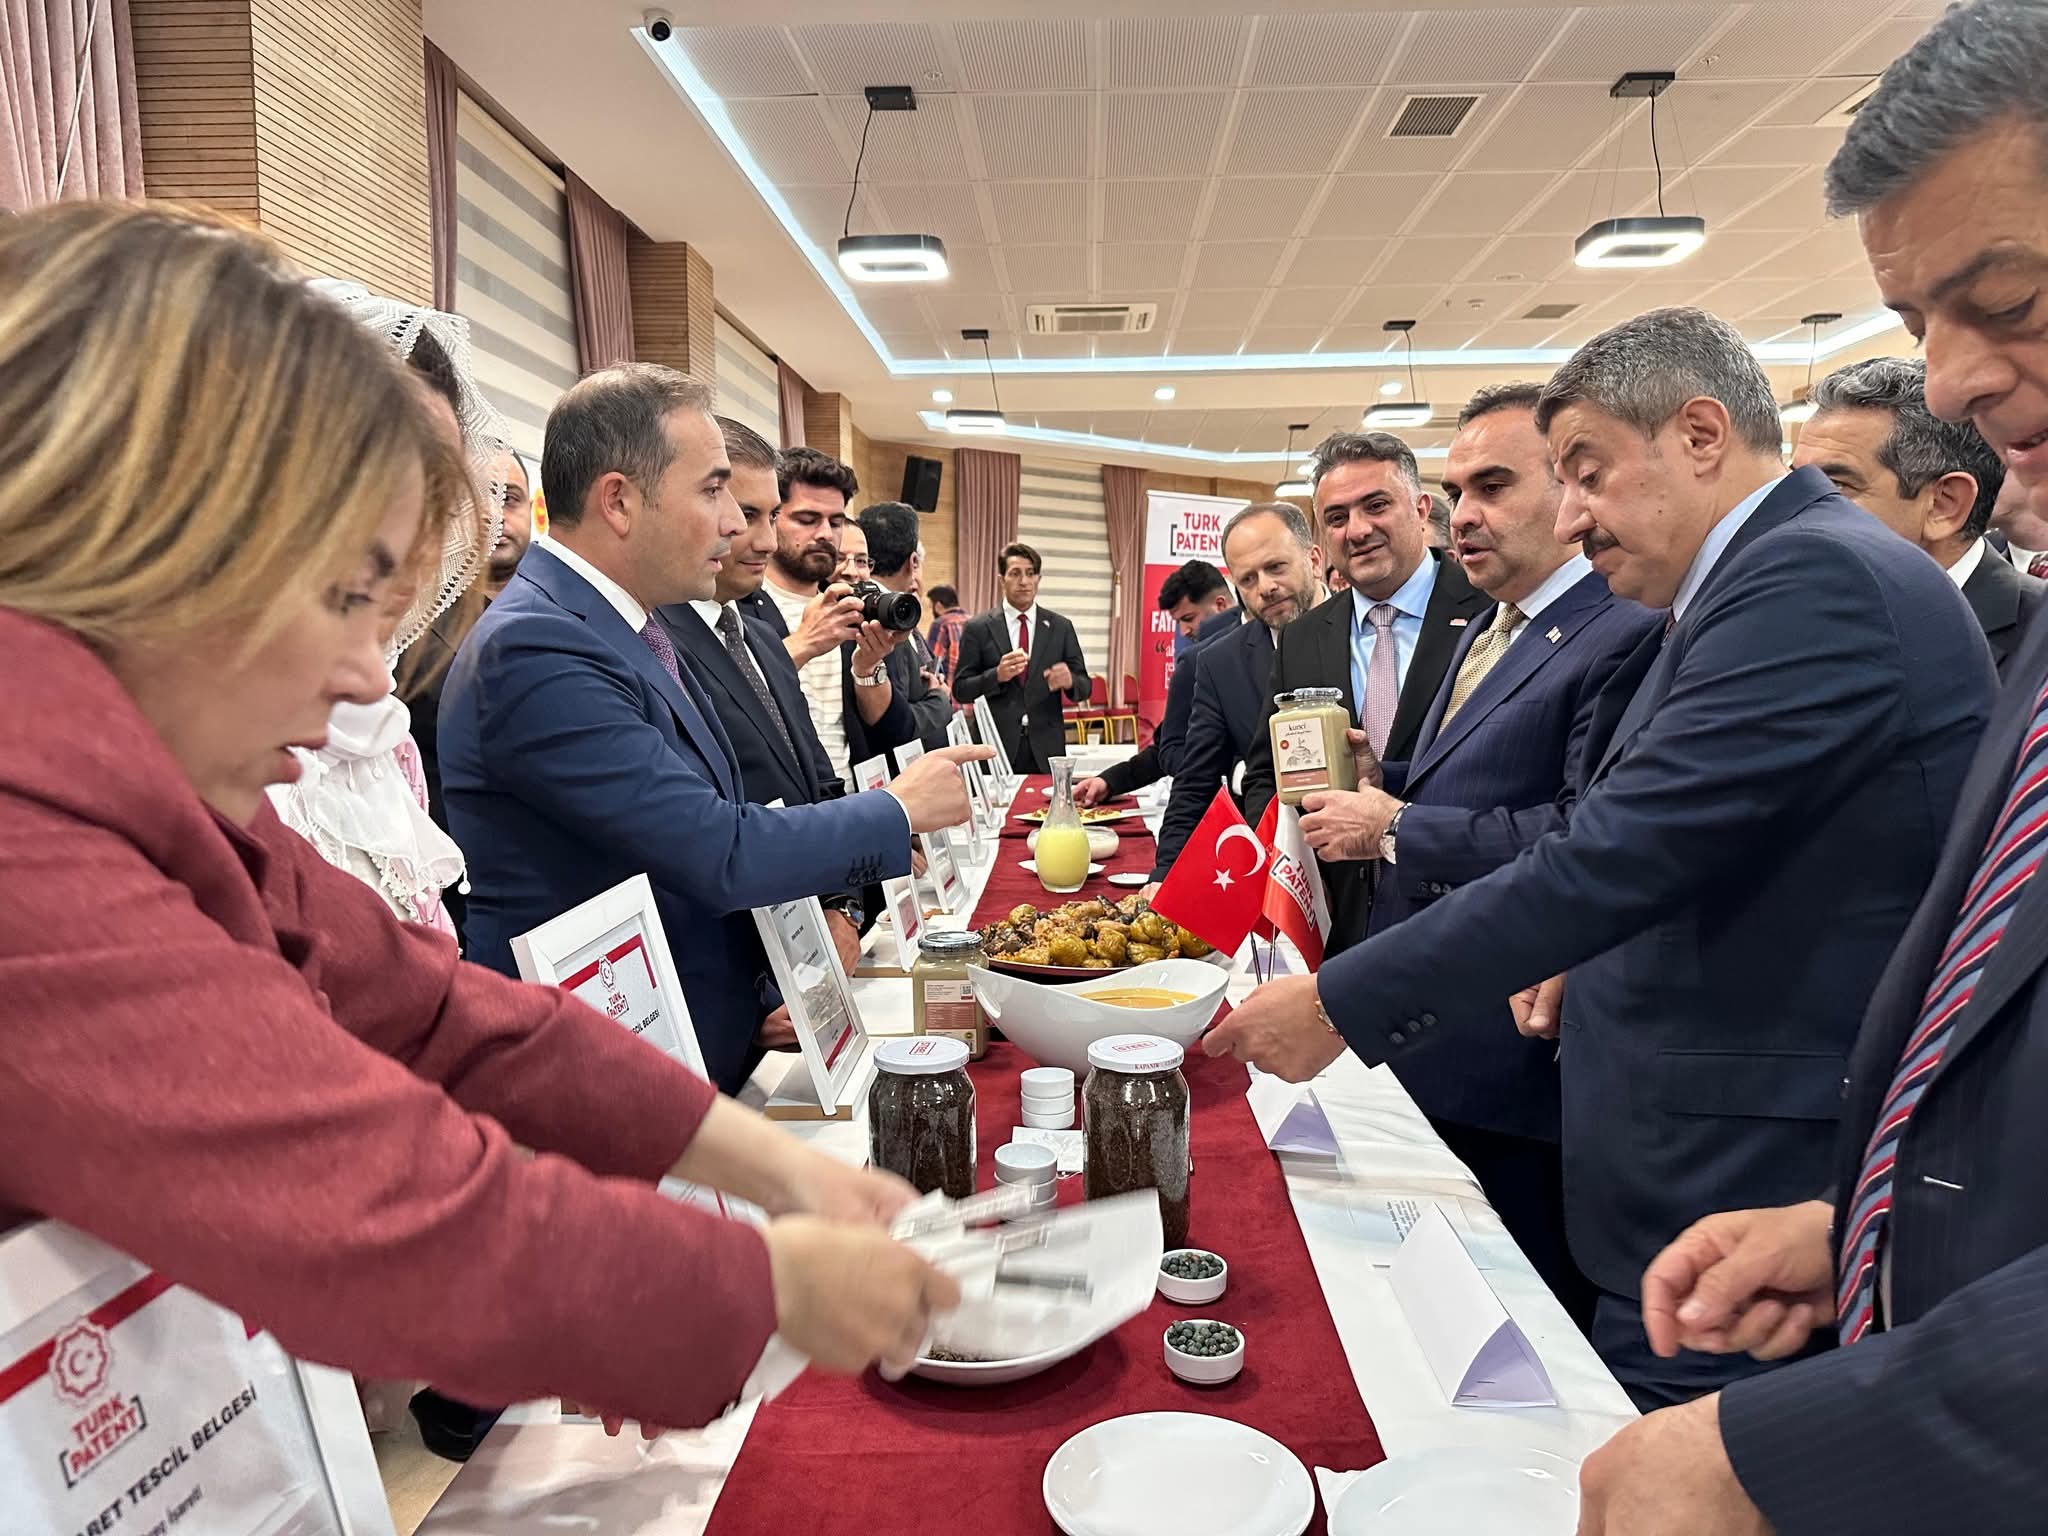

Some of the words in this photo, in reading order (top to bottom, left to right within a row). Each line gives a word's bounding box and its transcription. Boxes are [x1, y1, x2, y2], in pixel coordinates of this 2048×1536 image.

[1176, 532, 1223, 551] PATEN
[1184, 512, 1221, 532] TURK
[69, 1408, 138, 1474] PATENT
[72, 1393, 125, 1442] TURK
[125, 1446, 190, 1505] TESCİL
[191, 1380, 257, 1451] BELGESİ
